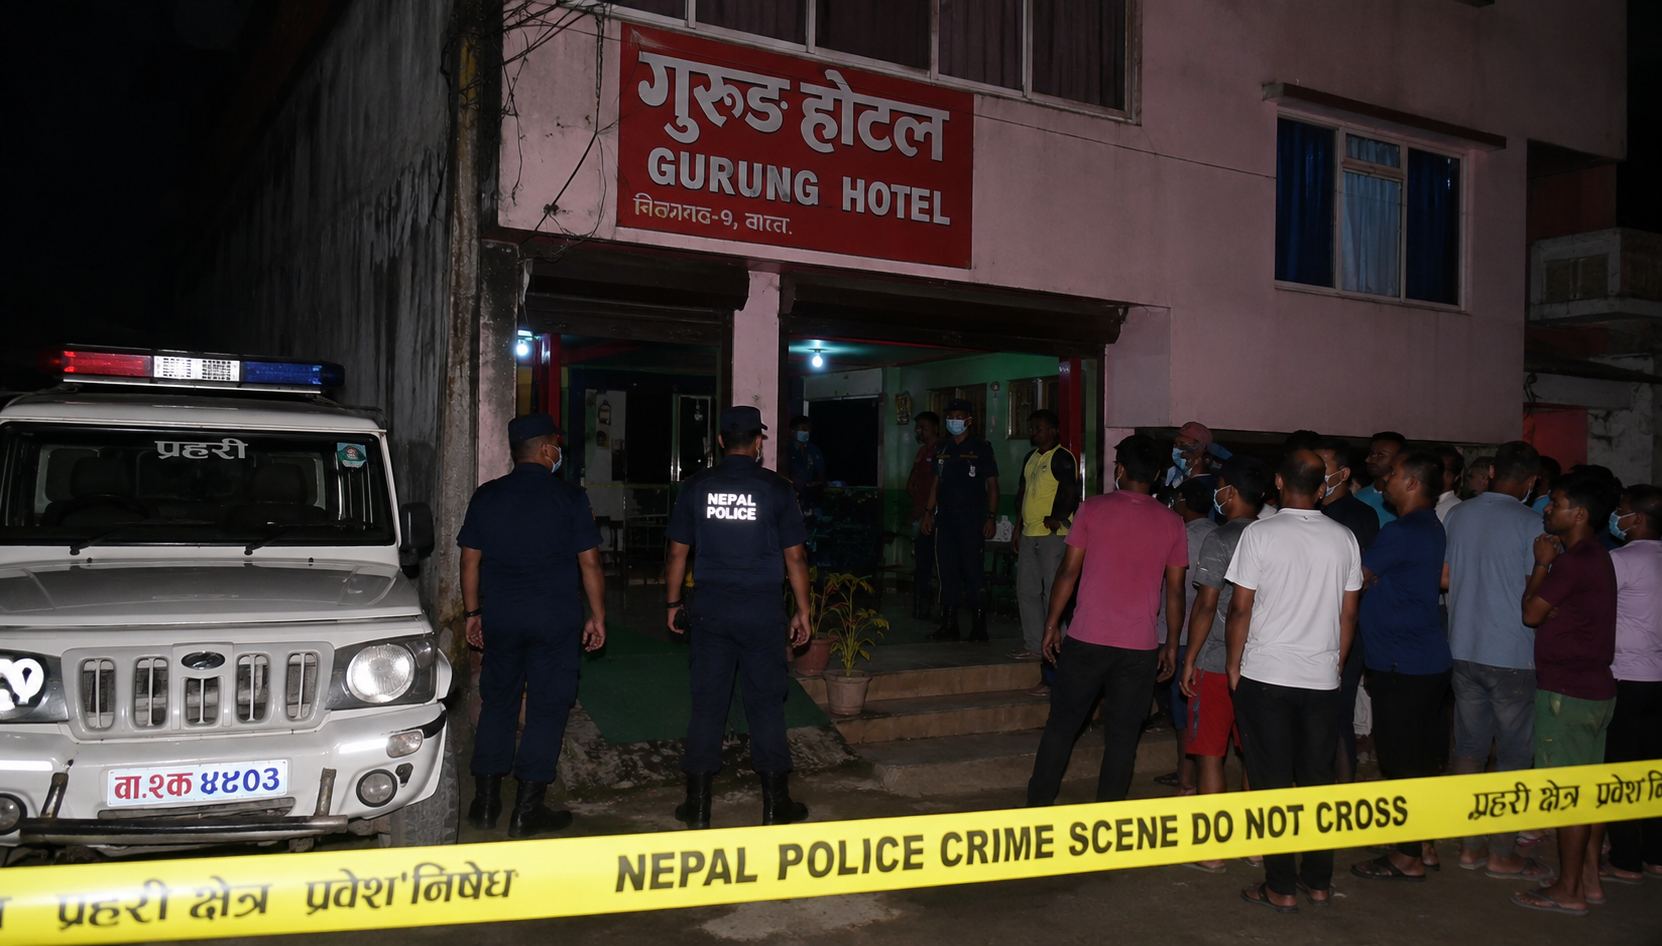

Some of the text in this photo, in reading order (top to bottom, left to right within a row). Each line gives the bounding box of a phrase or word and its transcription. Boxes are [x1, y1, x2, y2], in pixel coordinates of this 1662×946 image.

[800, 69, 950, 162] होटल
[648, 147, 950, 226] GURUNG HOTEL
[154, 438, 249, 460] प्रहरी
[706, 507, 757, 520] POLICE
[707, 493, 756, 506] NEPAL
[1539, 780, 1580, 812] क्षेत्र
[615, 795, 1409, 893] NEPAL POLICE CRIME SCENE DO NOT CROSS
[56, 878, 172, 931] प्रहरी
[190, 875, 273, 921] क्षेत्र
